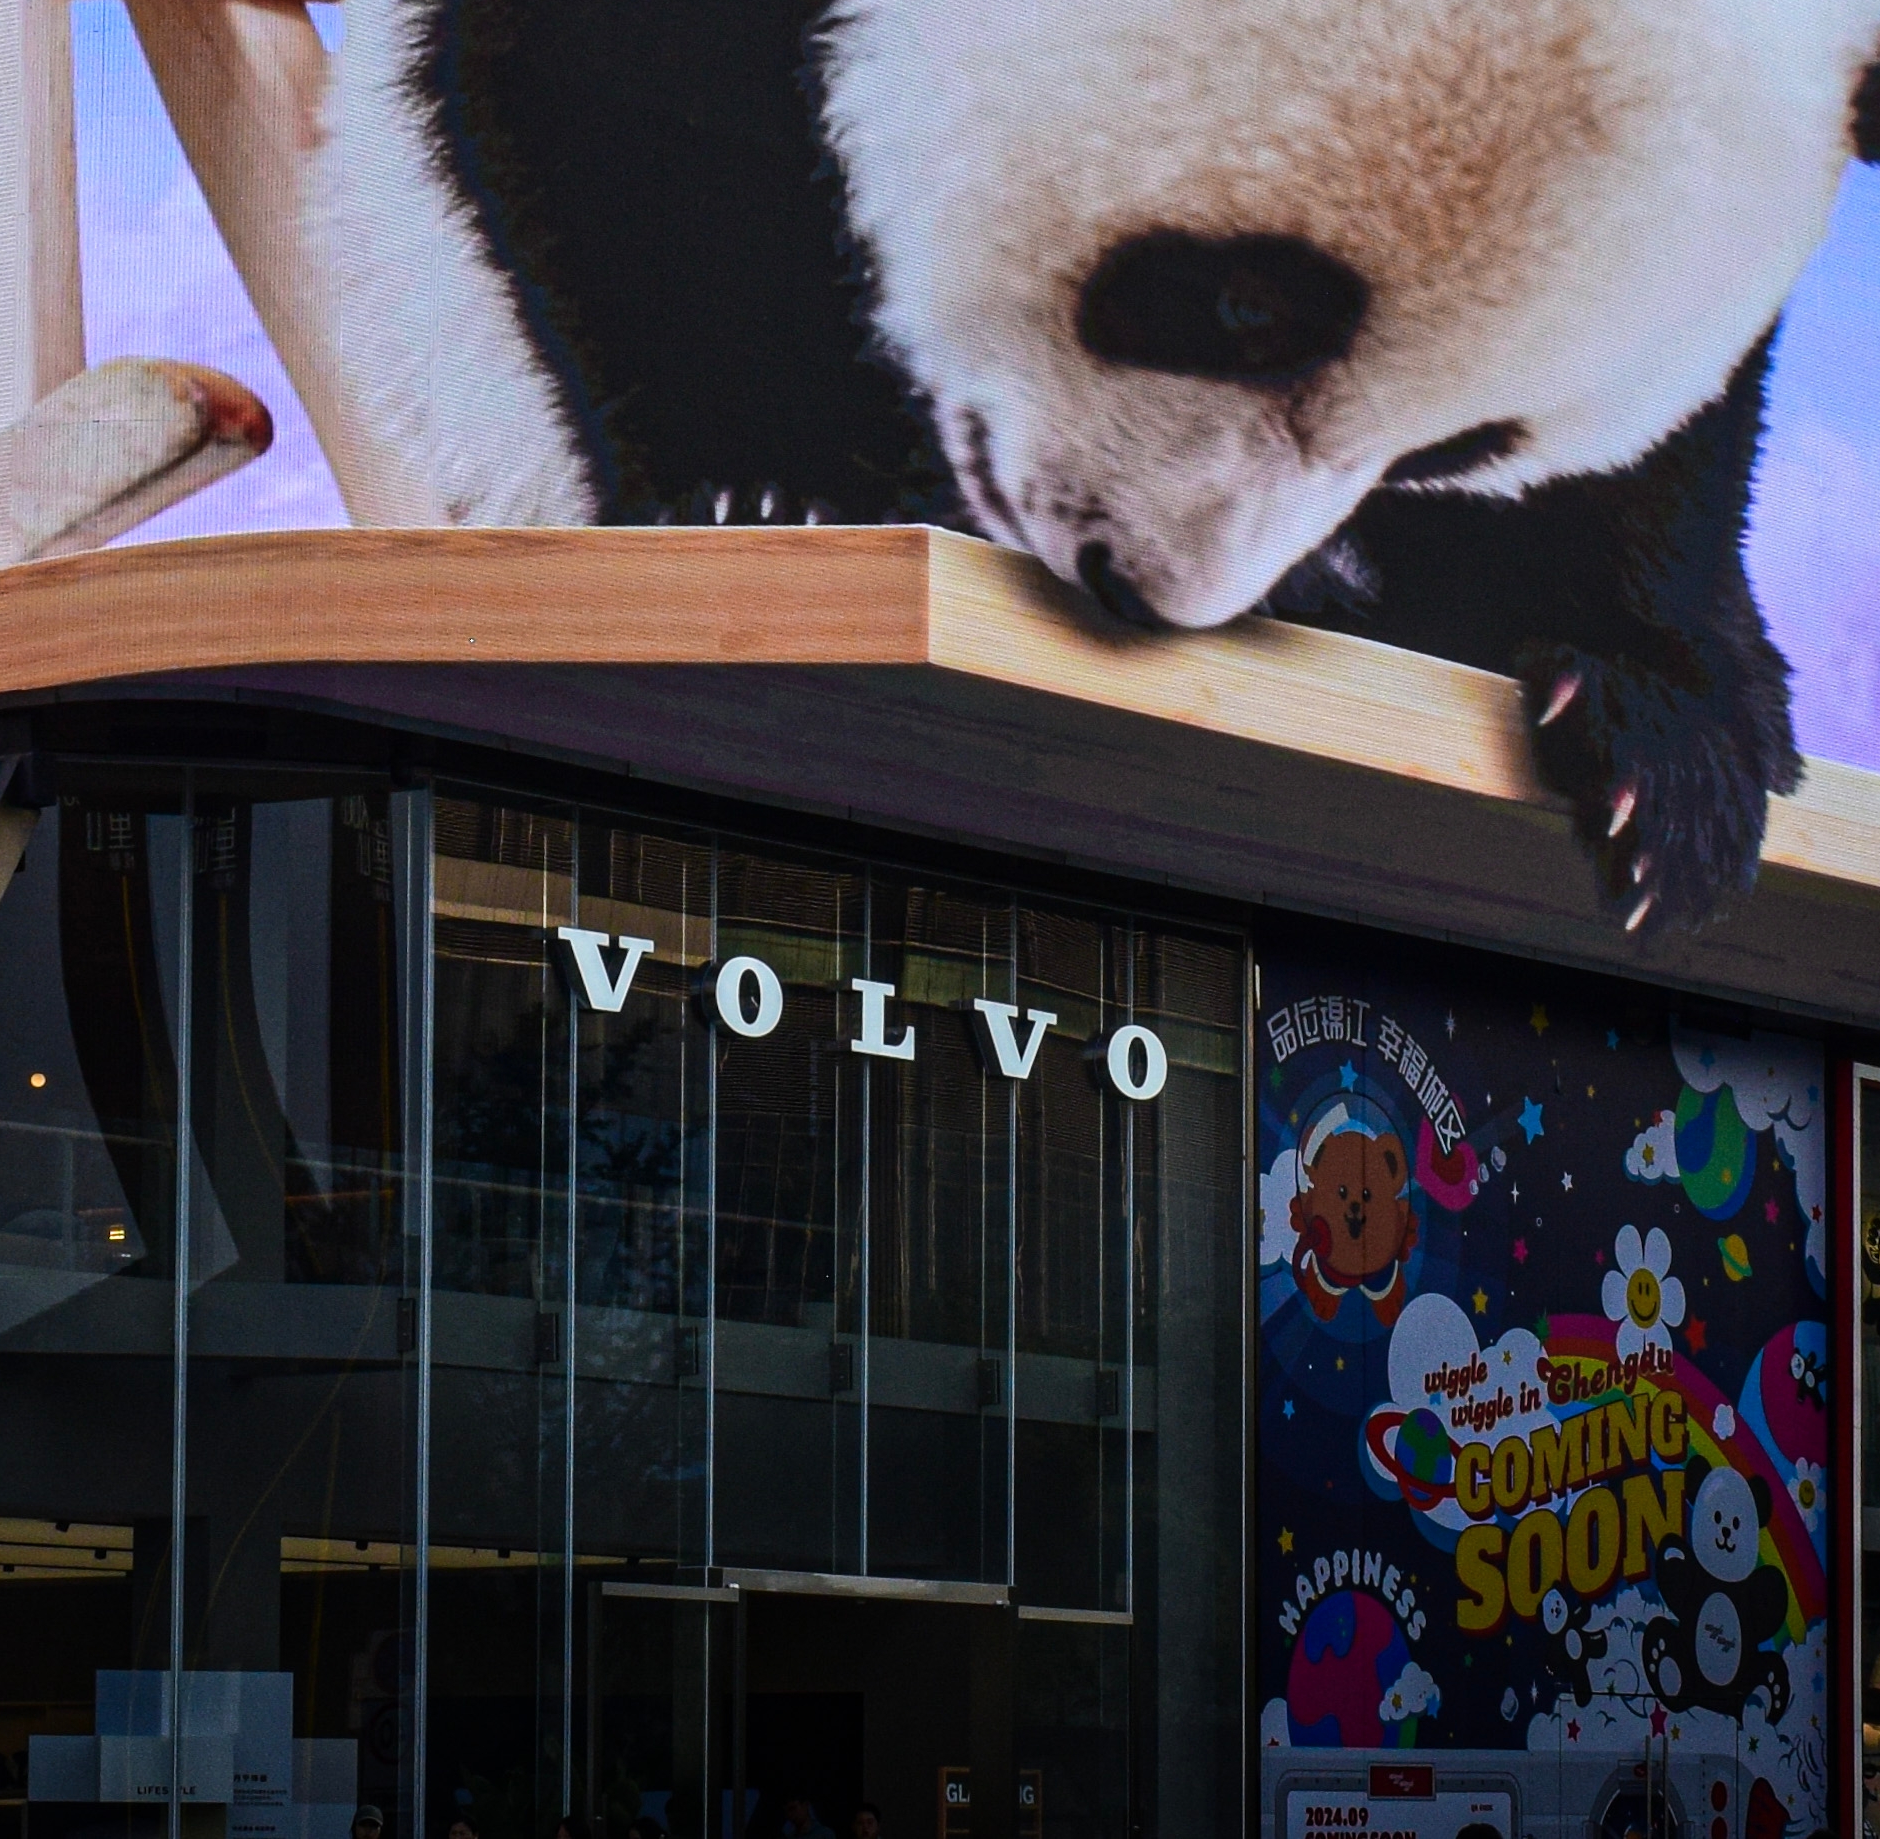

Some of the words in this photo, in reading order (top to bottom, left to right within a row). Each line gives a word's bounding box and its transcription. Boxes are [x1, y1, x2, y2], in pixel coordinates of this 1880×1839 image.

[557, 925, 1169, 1102] VOLVO
[1266, 994, 1371, 1064] 品位锦江
[1376, 1014, 1467, 1155] 幸福城区
[1424, 1352, 1488, 1399] wiggle
[1451, 1386, 1514, 1433] wiggle
[1519, 1381, 1542, 1412] in
[1536, 1341, 1675, 1406] Chengdu
[1455, 1389, 1689, 1521] COMING
[1277, 1546, 1428, 1642] HAPPINESS
[1455, 1469, 1688, 1637] SOON
[136, 1785, 196, 1795] LIFESLE
[1305, 1806, 1369, 1827] 2024.09
